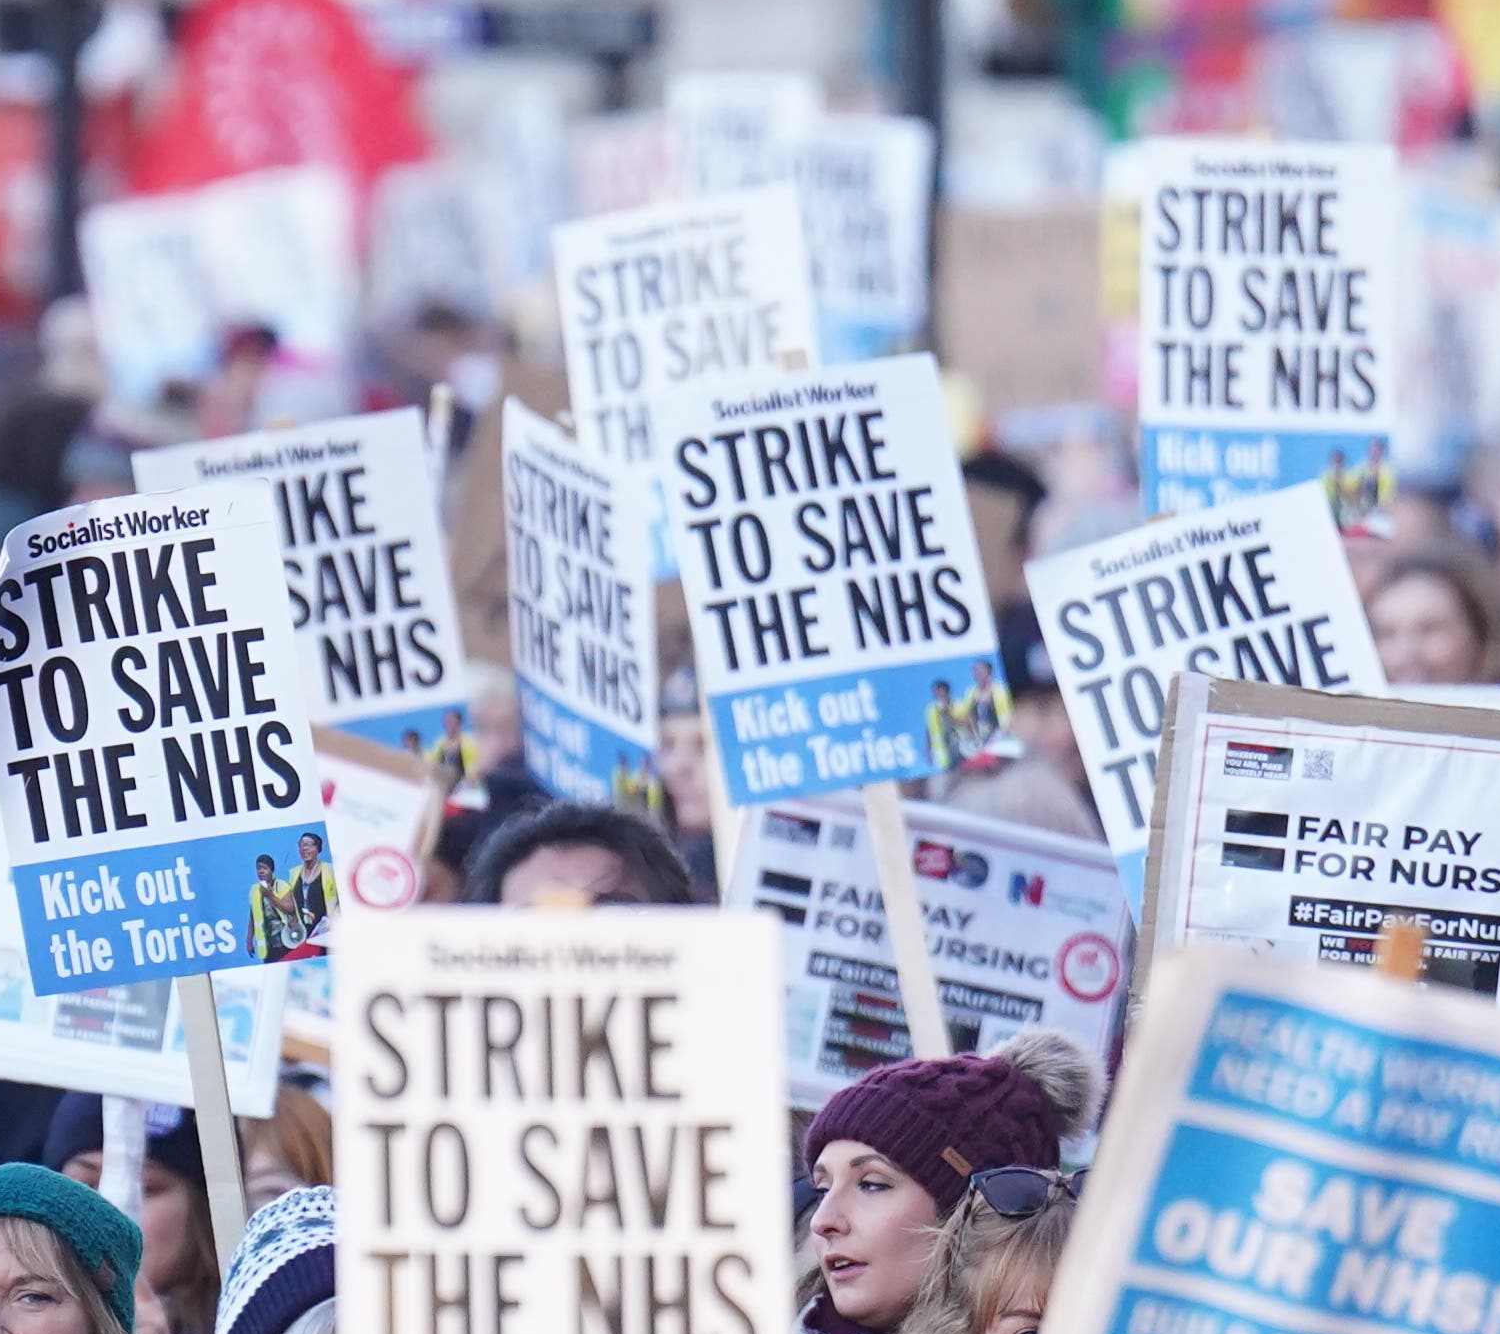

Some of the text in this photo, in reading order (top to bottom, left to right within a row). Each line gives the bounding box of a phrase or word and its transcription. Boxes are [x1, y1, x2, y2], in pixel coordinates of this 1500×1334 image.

[1156, 187, 1338, 258] STRIKE
[1156, 264, 1368, 337] TO SAVE
[712, 381, 879, 420] Socialist Worker
[1158, 340, 1378, 414] THE NHS
[675, 409, 898, 511] STRIKE
[27, 504, 210, 558] Socialist Worker
[688, 485, 946, 591] TO SAVE
[1183, 515, 1264, 554] Worker
[706, 567, 972, 672] THE NHS
[1057, 546, 1291, 675] STRIKE
[732, 681, 879, 736] Kick out
[8, 720, 301, 844] THE NHS
[741, 729, 914, 793] the Tories
[1293, 851, 1373, 881] FOR
[1297, 816, 1483, 857] FAIR PAY
[39, 855, 196, 920] Kick out
[50, 916, 237, 979] the Tories
[815, 911, 884, 944] FOR
[1320, 950, 1350, 962] FOR
[1434, 947, 1500, 963] FAIR PAY
[363, 992, 682, 1103] STRIKE
[363, 1122, 736, 1231] TO SAVE
[1250, 1156, 1459, 1253] SAVE
[1152, 1196, 1323, 1287] OUR
